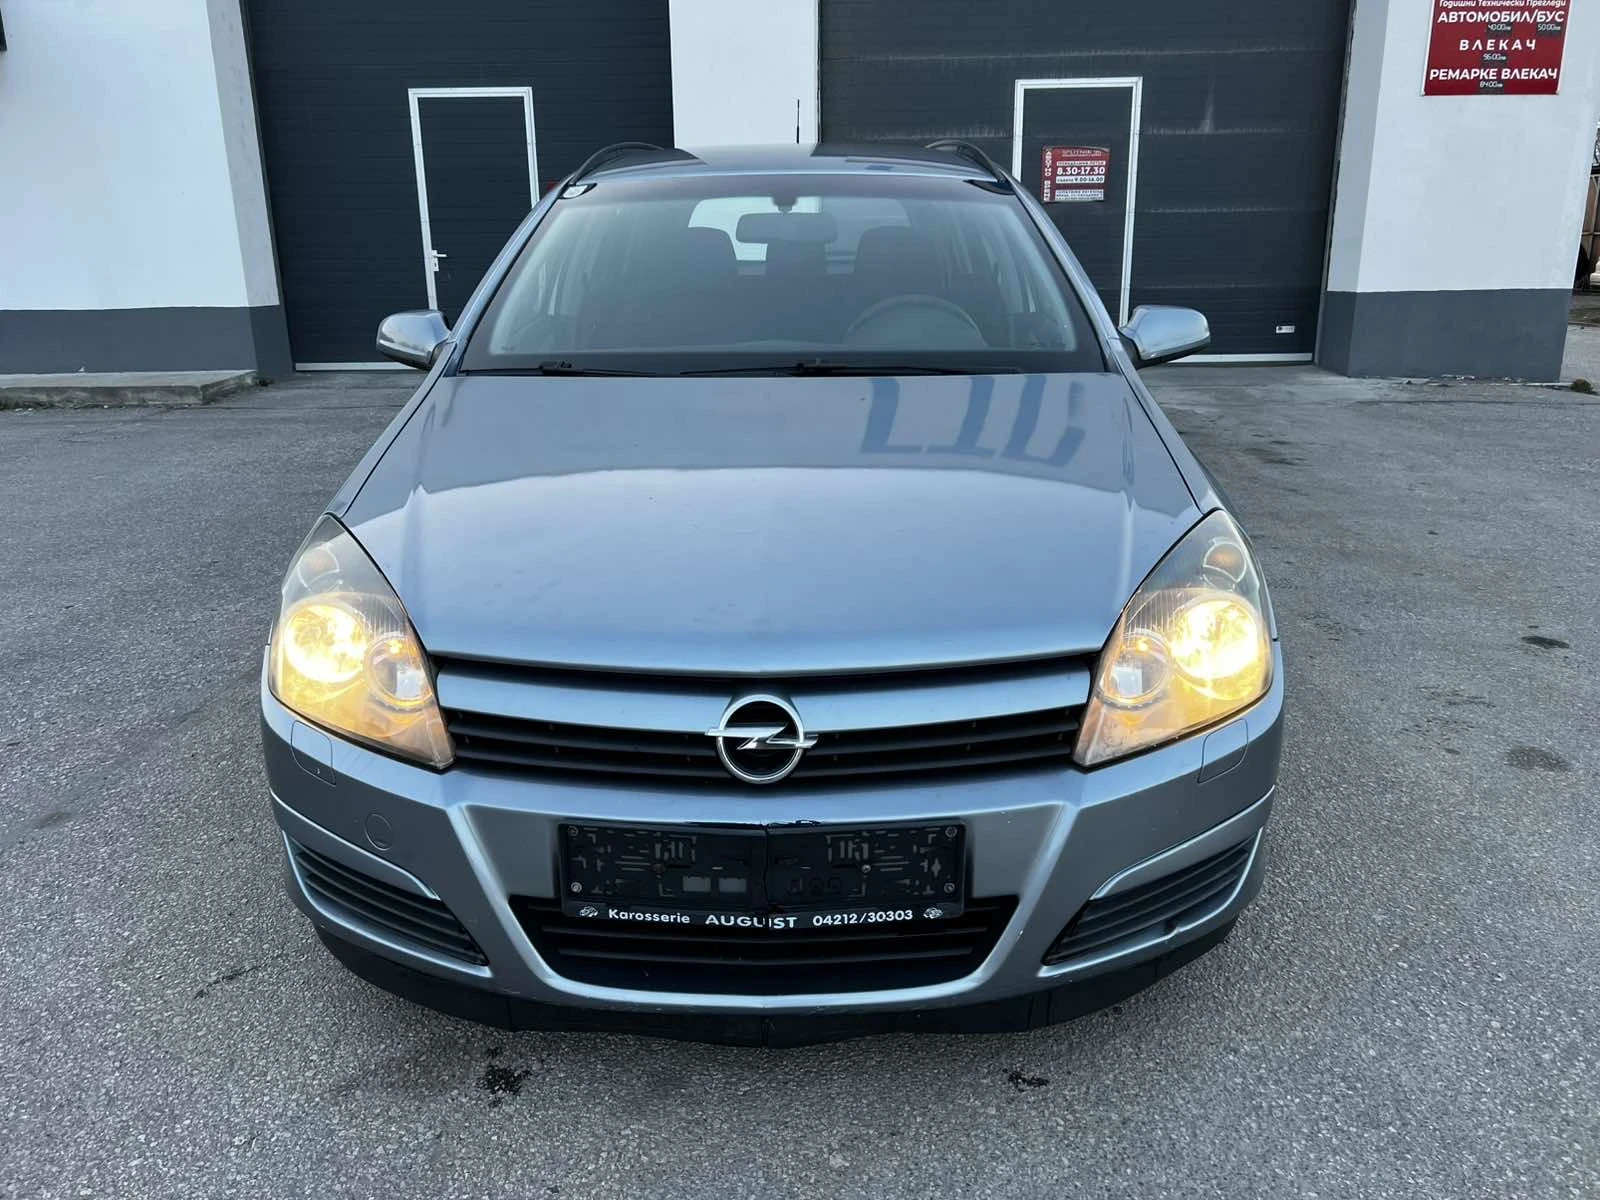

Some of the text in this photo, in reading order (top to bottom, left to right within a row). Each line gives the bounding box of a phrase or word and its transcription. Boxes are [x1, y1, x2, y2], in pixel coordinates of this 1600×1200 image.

[1439, 0, 1476, 8] Годишни
[1437, 10, 1565, 23] АВТОМОБИЛ/БУС
[1430, 68, 1558, 80] РЕМАРКЕ ВЛЕКАЧ
[608, 908, 914, 930] Karosserie AUGUST 04212/30303
